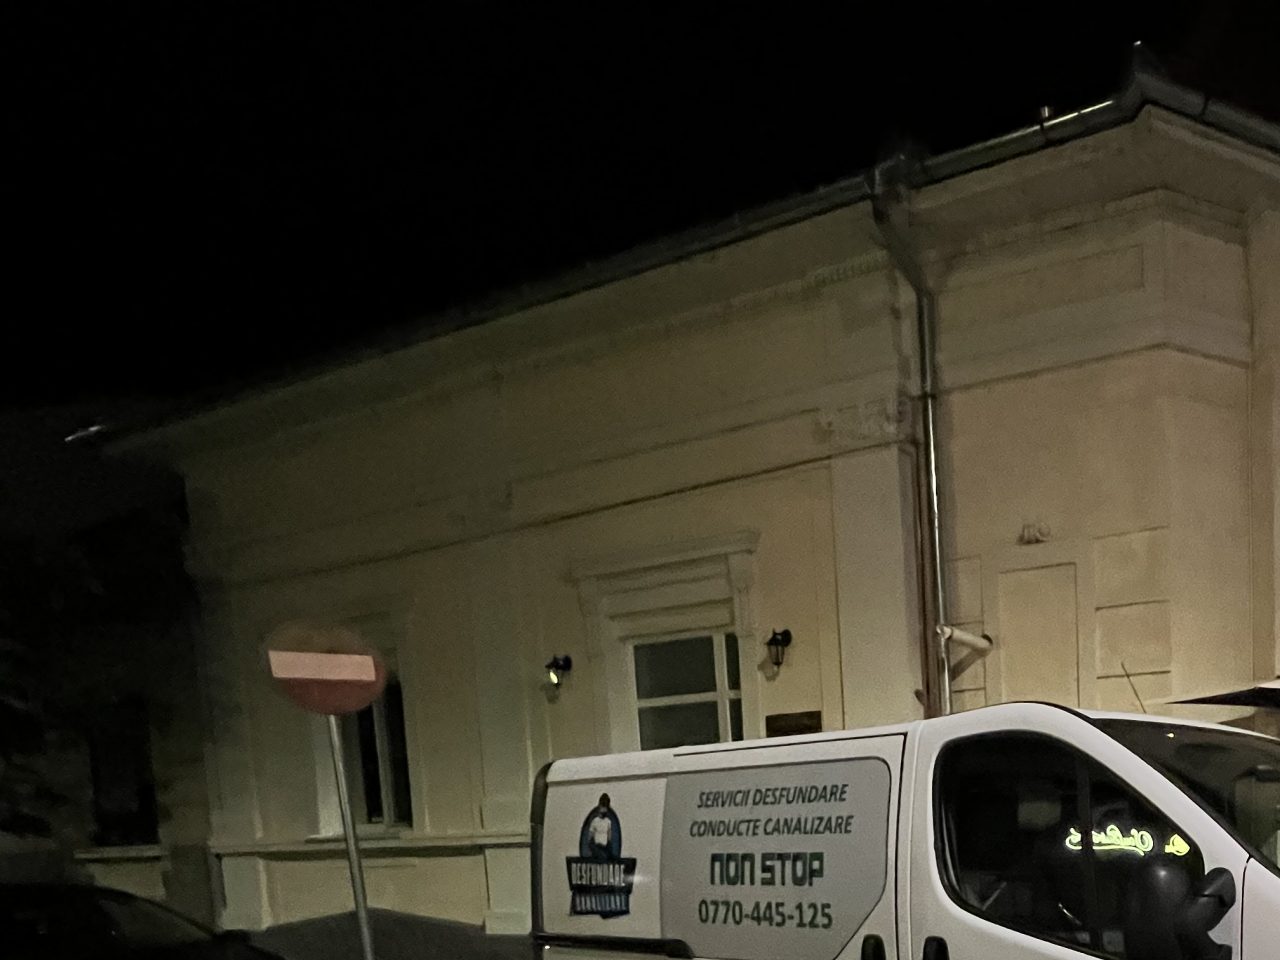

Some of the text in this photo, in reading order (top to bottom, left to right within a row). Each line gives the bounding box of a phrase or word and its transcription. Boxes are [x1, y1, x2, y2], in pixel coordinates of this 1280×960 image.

[752, 783, 849, 806] DESFUNDARE
[689, 814, 854, 838] CONDUCTE CANALIZARE
[760, 851, 825, 887] STOP
[697, 898, 833, 930] 0770-445-125
